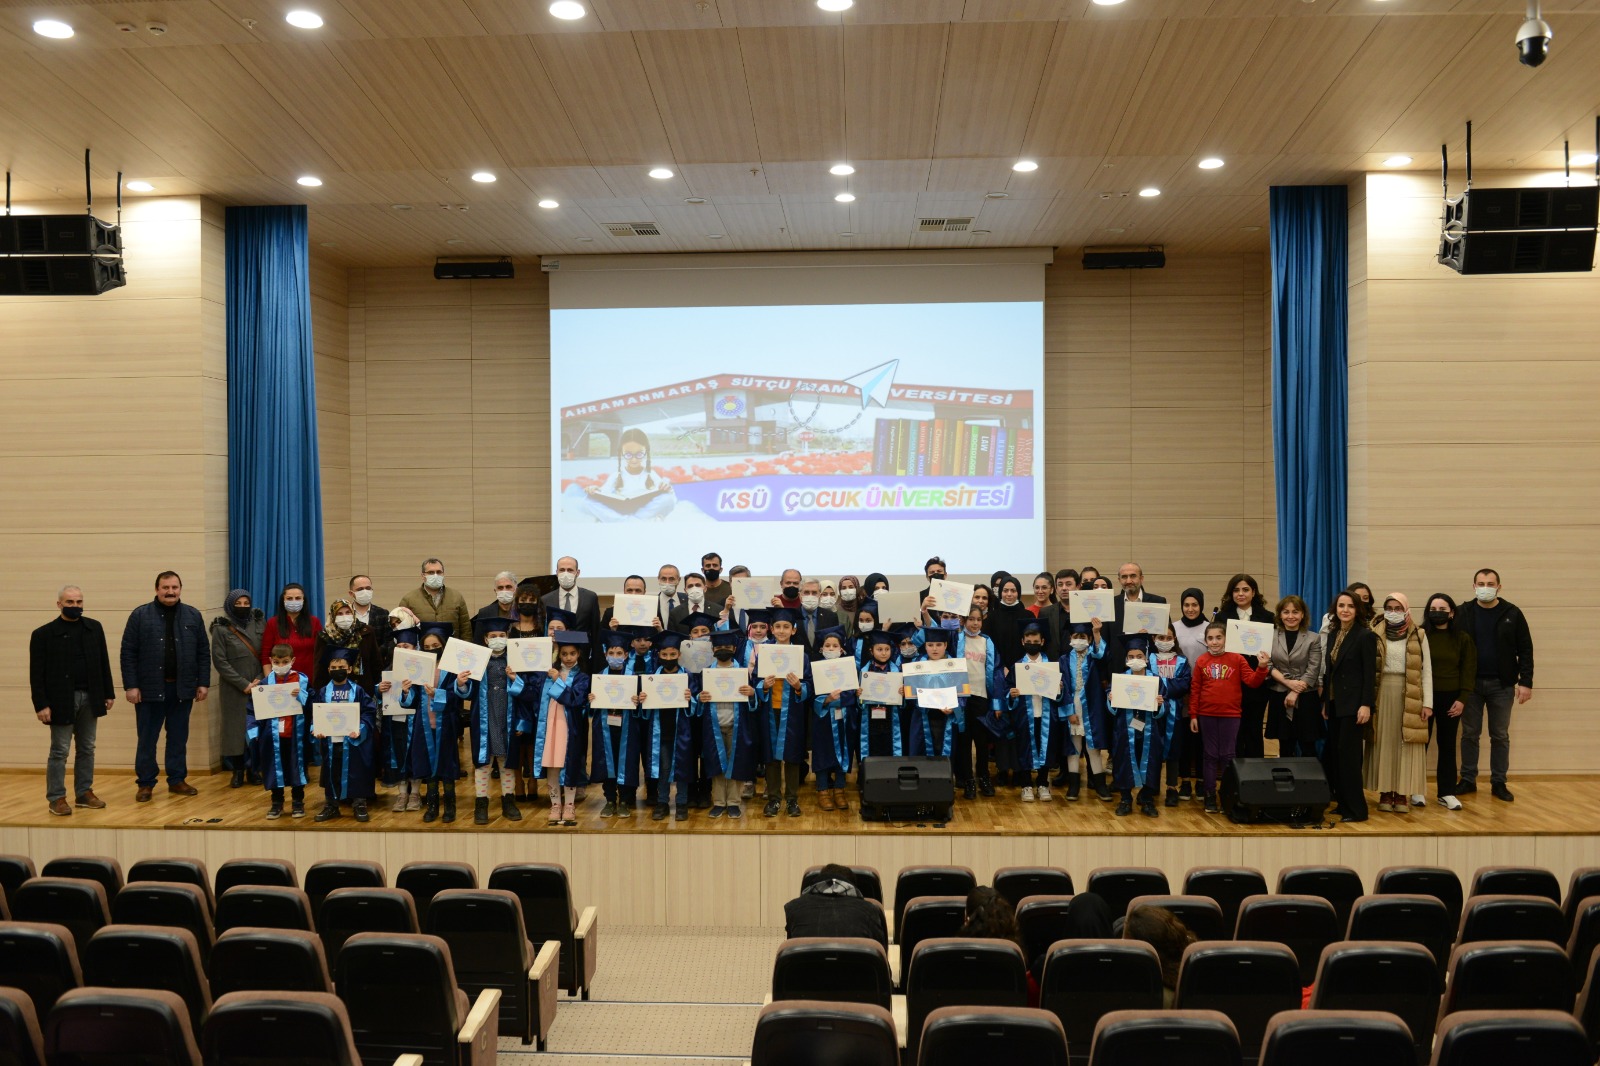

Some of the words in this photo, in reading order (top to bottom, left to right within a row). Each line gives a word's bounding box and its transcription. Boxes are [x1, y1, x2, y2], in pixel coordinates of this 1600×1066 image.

[561, 378, 719, 419] AHRAMANMARAŞ
[731, 376, 791, 391] SÜTÇÜ
[932, 428, 942, 464] Chemistry
[970, 433, 978, 476] SOCIOLOGY
[980, 436, 990, 452] LAW
[1023, 438, 1033, 477] WORLD
[720, 488, 768, 509] KSÜ
[785, 490, 861, 512] ÇOCUK
[866, 485, 1011, 508] ÜNİVERSİTESİ
